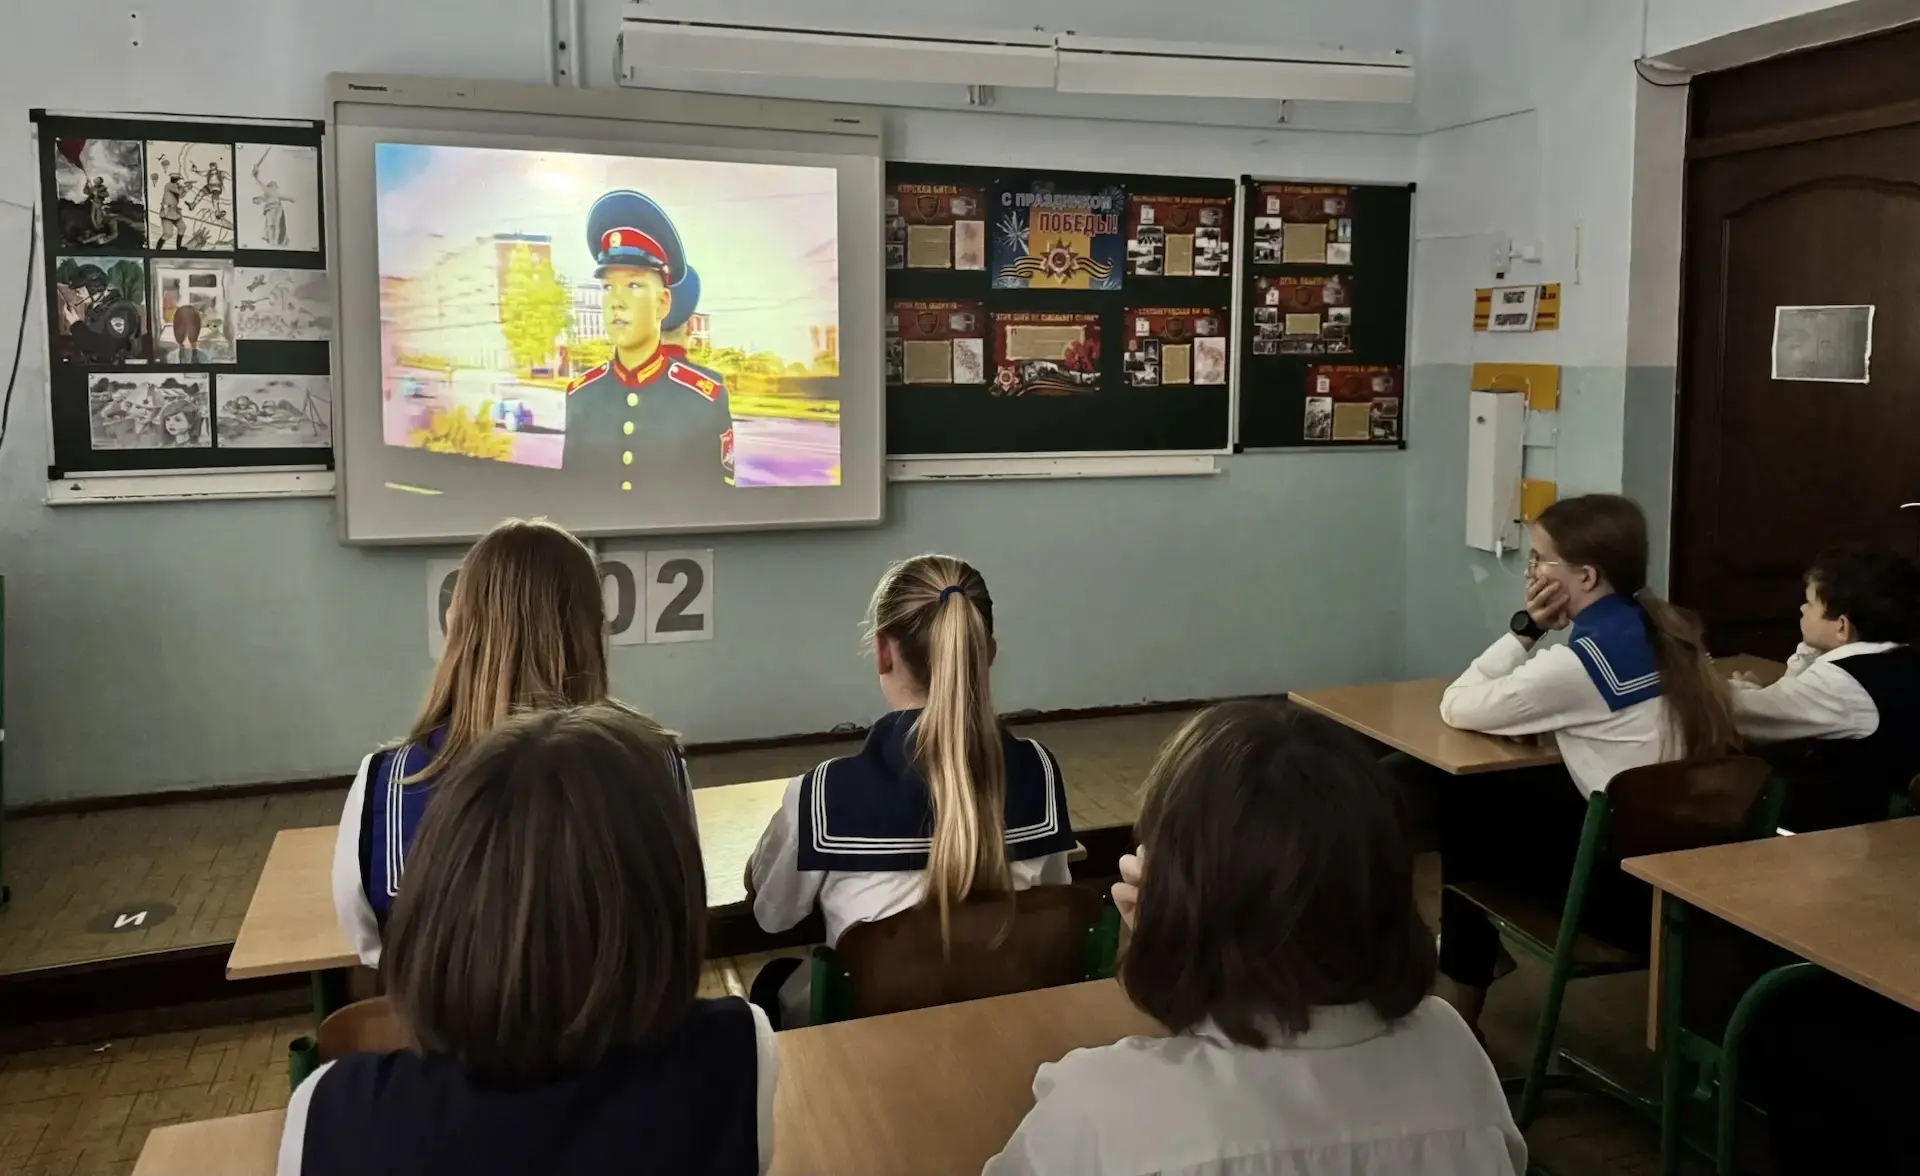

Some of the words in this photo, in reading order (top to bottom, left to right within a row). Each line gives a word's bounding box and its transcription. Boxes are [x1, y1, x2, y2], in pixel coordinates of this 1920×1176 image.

[1001, 192, 1012, 206] С
[1016, 193, 1112, 210] ПРАЗДНИКОМ
[1040, 213, 1118, 237] ПОБЕДЫ!
